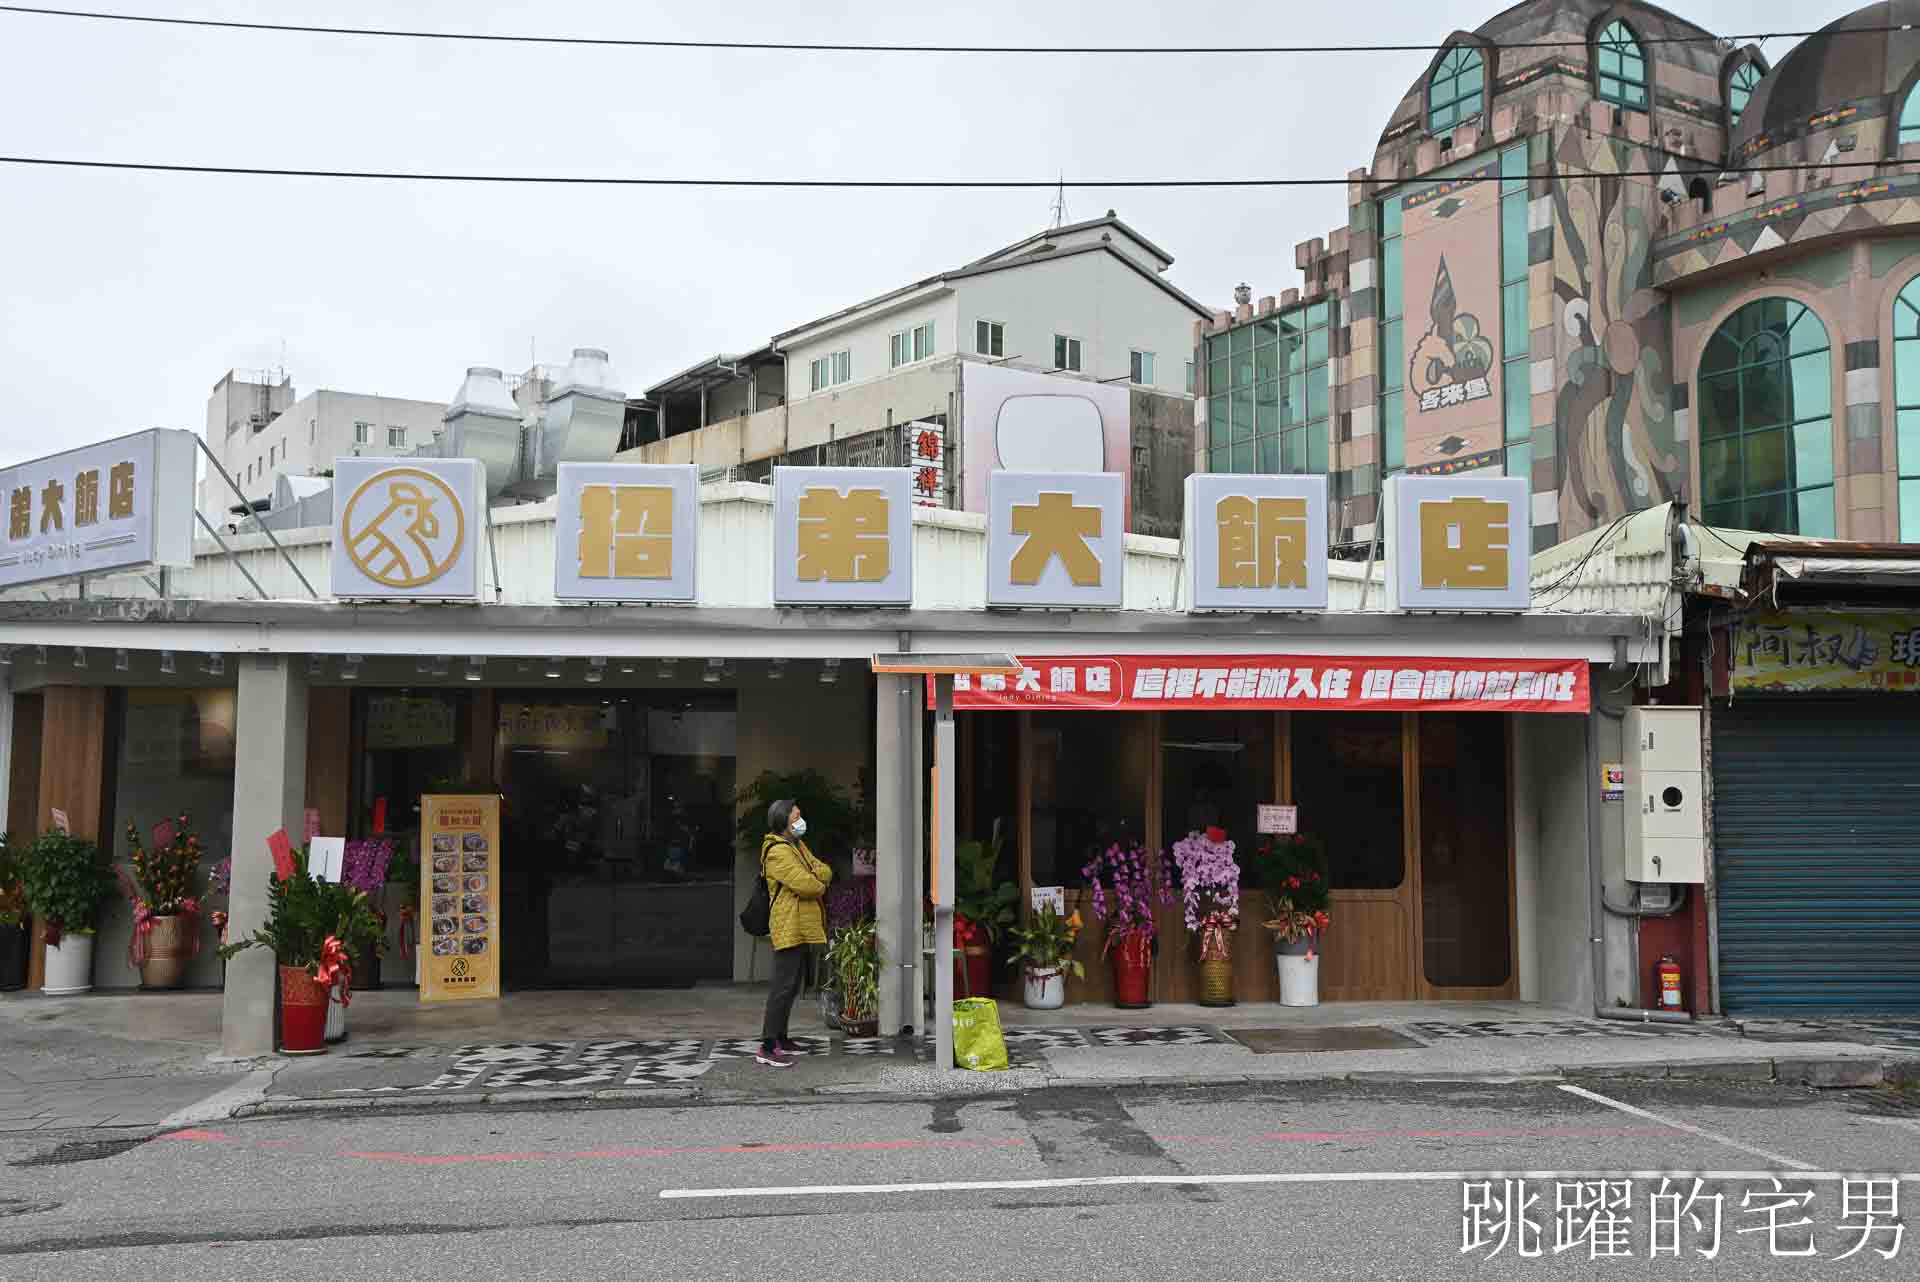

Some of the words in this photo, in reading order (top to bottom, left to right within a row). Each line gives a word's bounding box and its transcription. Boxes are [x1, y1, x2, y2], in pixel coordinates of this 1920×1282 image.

[0, 461, 135, 540] 弟大飯店
[916, 430, 939, 507] 錦祥
[577, 484, 1509, 590] 招弟大飯店
